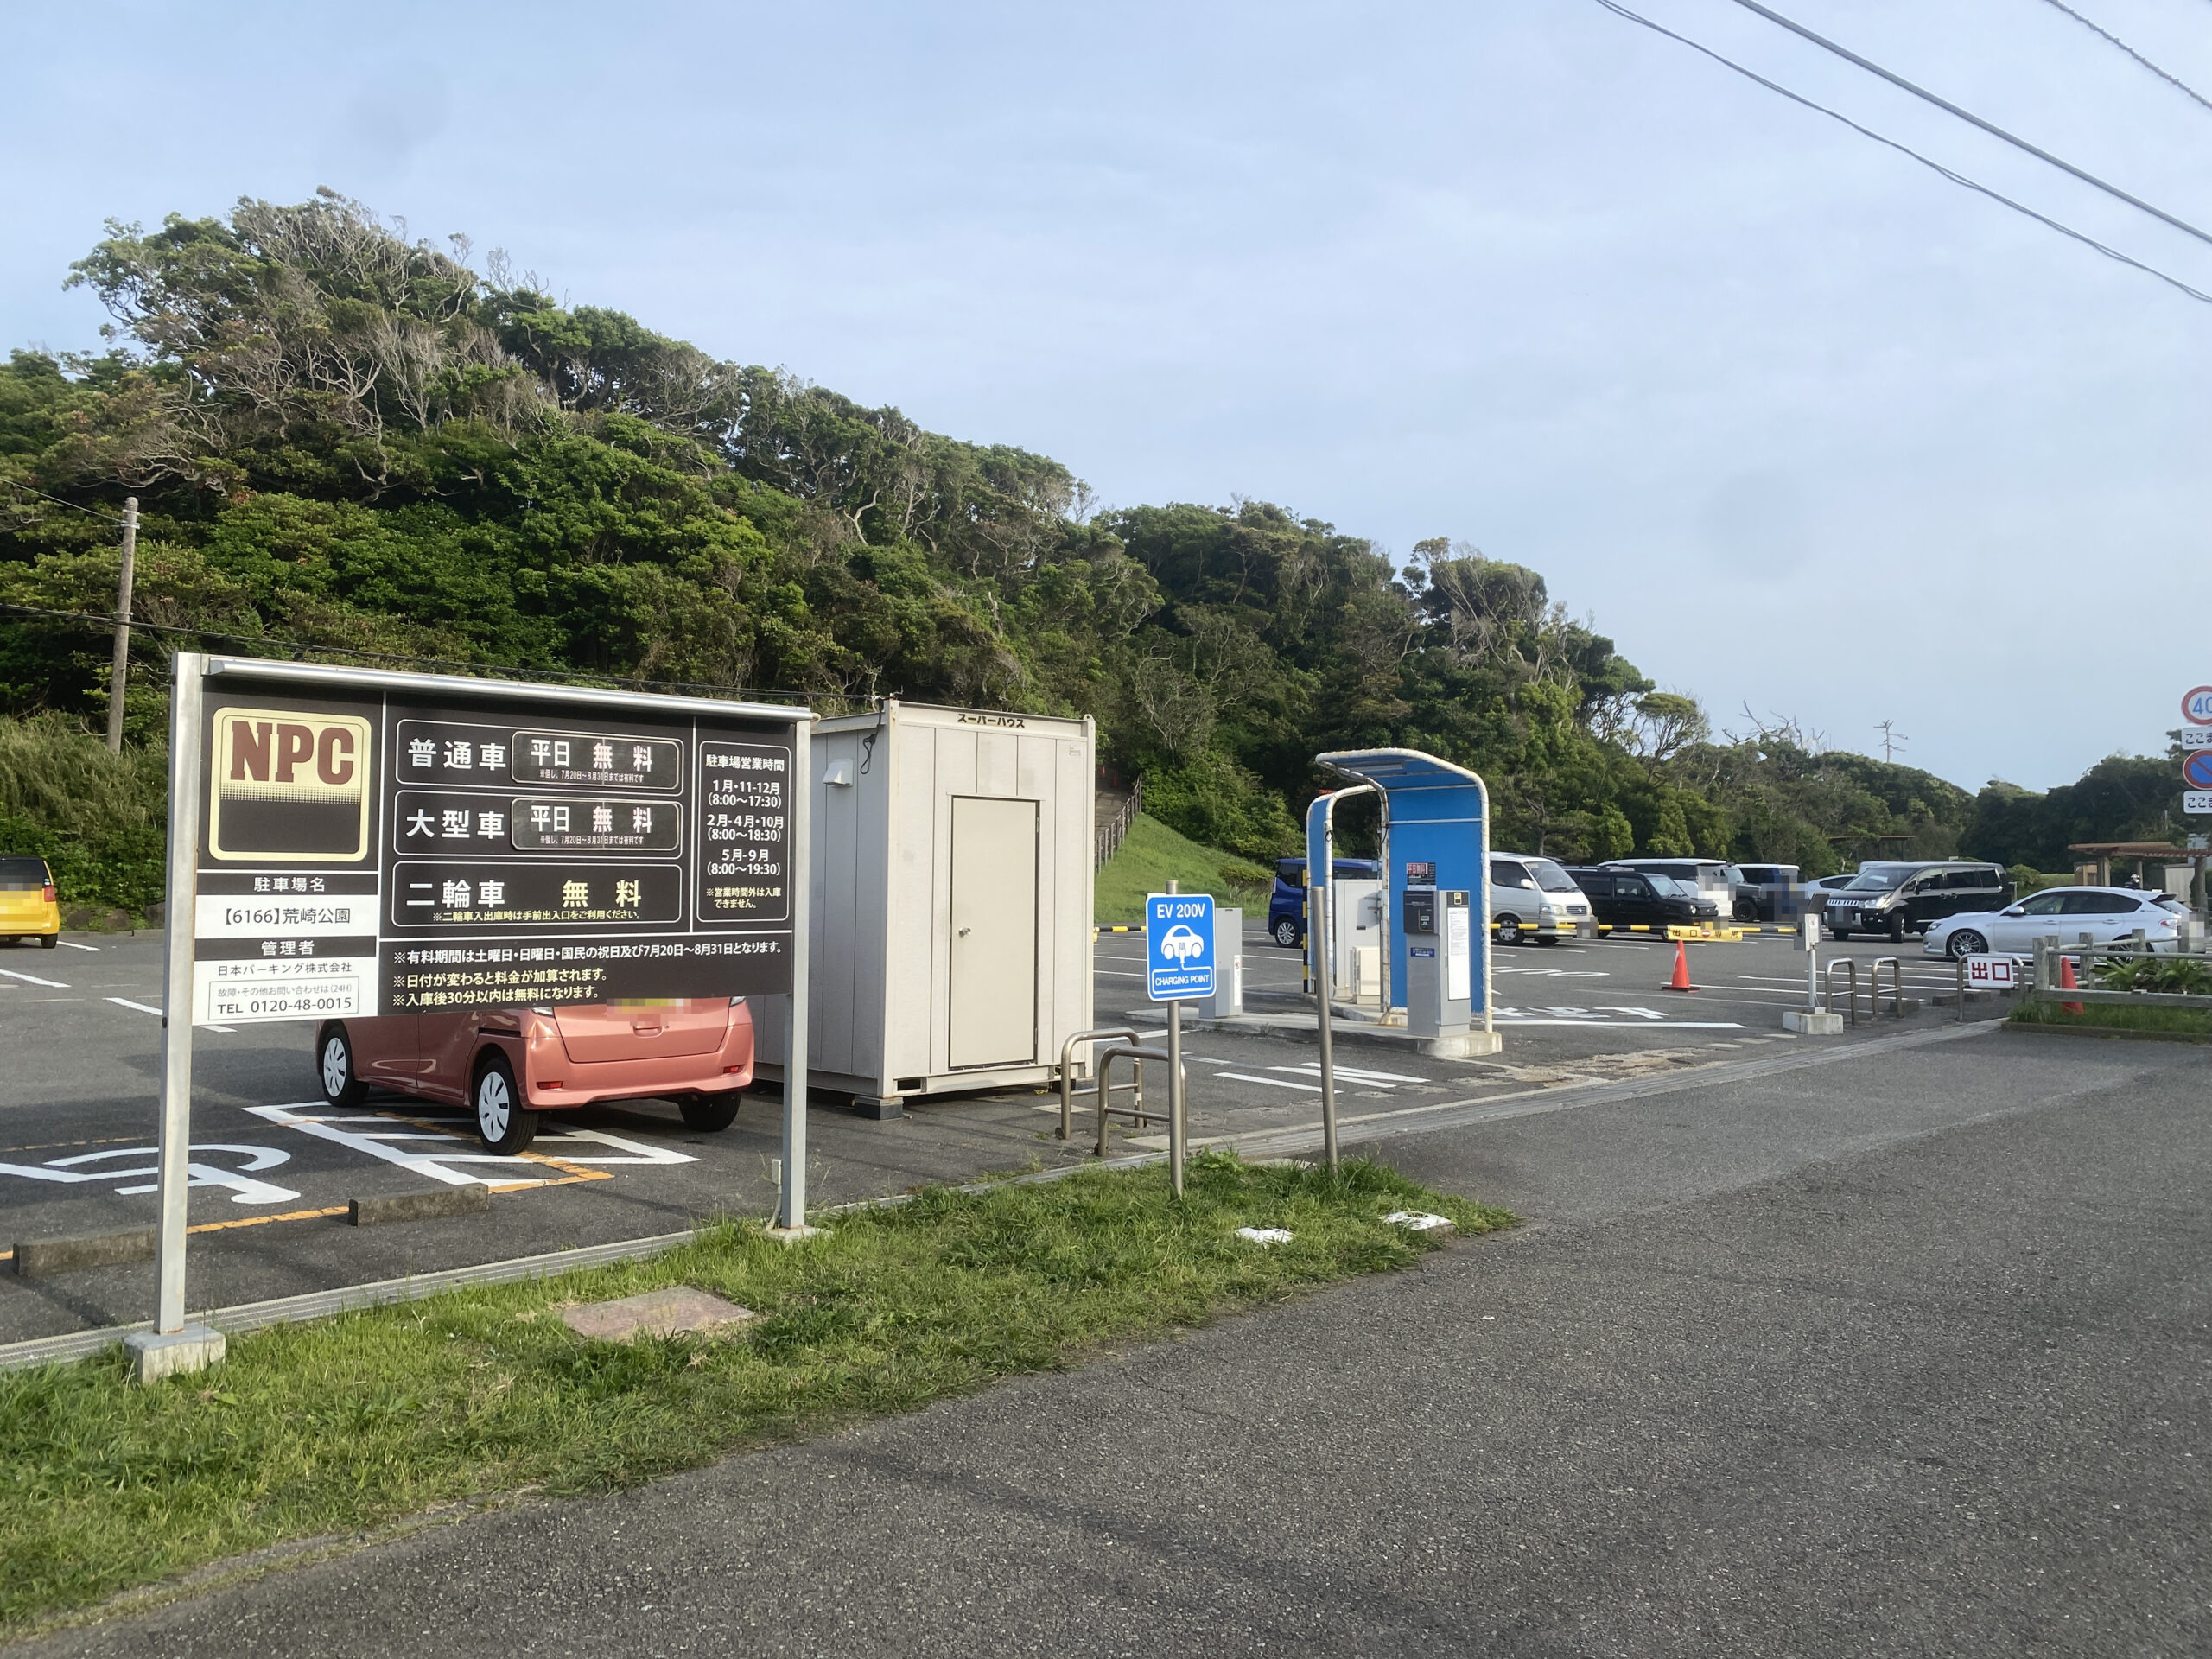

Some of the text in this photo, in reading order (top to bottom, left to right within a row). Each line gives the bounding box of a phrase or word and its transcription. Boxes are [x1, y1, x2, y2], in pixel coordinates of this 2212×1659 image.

[957, 713, 1025, 728] スーパーハウス
[230, 721, 354, 785] NPC
[408, 738, 652, 772] 普通車 平日 無料
[705, 754, 785, 772] 駐車場営業時間
[406, 805, 652, 840] 大型車 平日 無料
[253, 876, 326, 893] 駐車場名
[706, 887, 781, 898] ※営業時間外は入庫
[407, 880, 642, 908] 二輪車 無料
[714, 898, 757, 909] できません。
[1156, 903, 1205, 918] EV 200V
[226, 907, 351, 925] 【6166】荒崎公園
[261, 940, 315, 956] 管理者
[218, 962, 353, 976] 日本パーキング株式会社
[393, 967, 607, 988] ※日付が変わると料金が加算されます。
[1971, 962, 2010, 981] 出口
[1154, 974, 1210, 986] CHARGING POINT
[392, 984, 599, 1007] ※入庫後30分以内は無料になります。
[218, 996, 352, 1014] TEL 0120-48-0015
